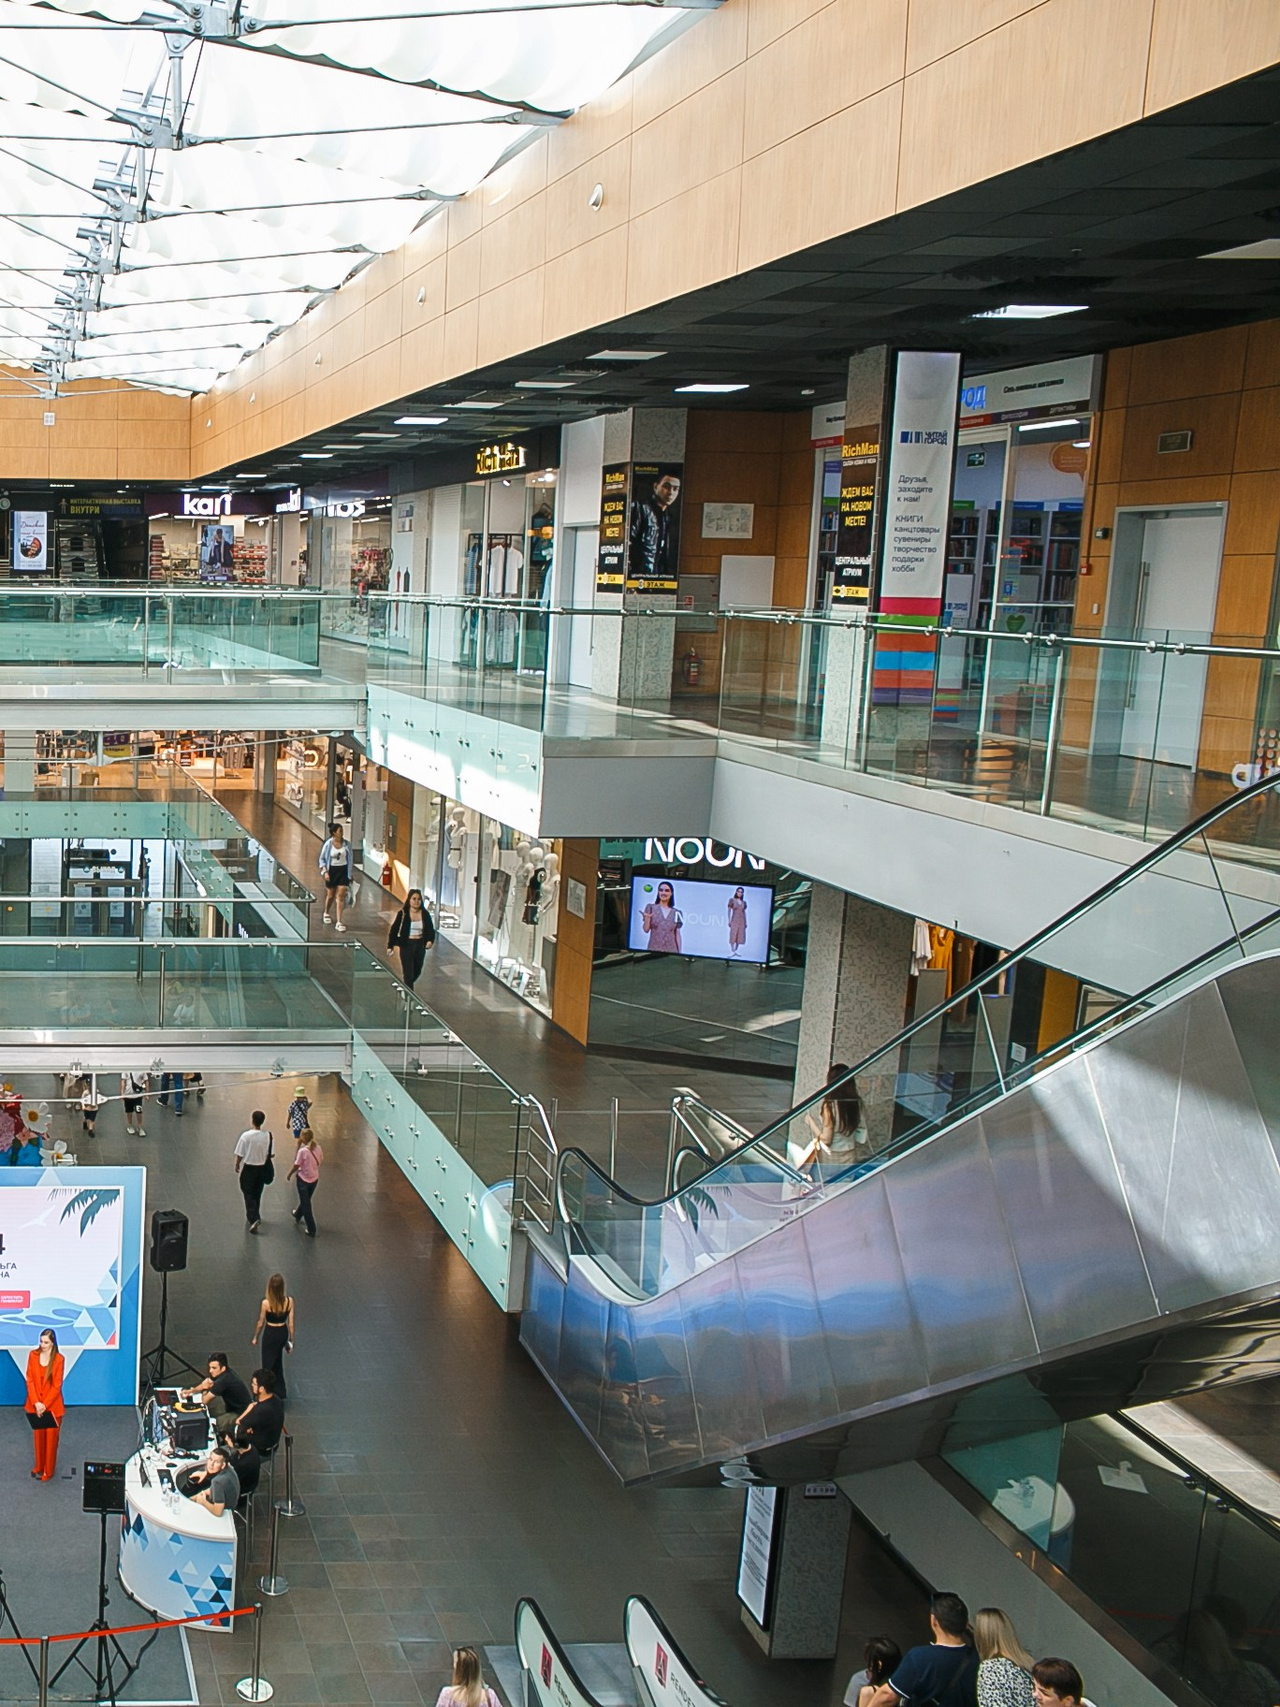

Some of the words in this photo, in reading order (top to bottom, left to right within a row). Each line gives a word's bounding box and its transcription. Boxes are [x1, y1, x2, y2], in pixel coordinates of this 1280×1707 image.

[842, 442, 880, 458] RichMan
[841, 487, 860, 499] ЖДЕМ
[862, 485, 874, 497] ВАС
[898, 486, 933, 494] заходите
[184, 492, 233, 515] kari
[841, 502, 850, 512] НА
[851, 501, 872, 512] НОВОМ
[70, 506, 100, 514] ВНУТРИ
[894, 526, 940, 535] канцтовары
[893, 546, 937, 554] творчество
[638, 579, 644, 589] 3
[644, 837, 766, 870] NOUN
[675, 911, 725, 927] NOUN
